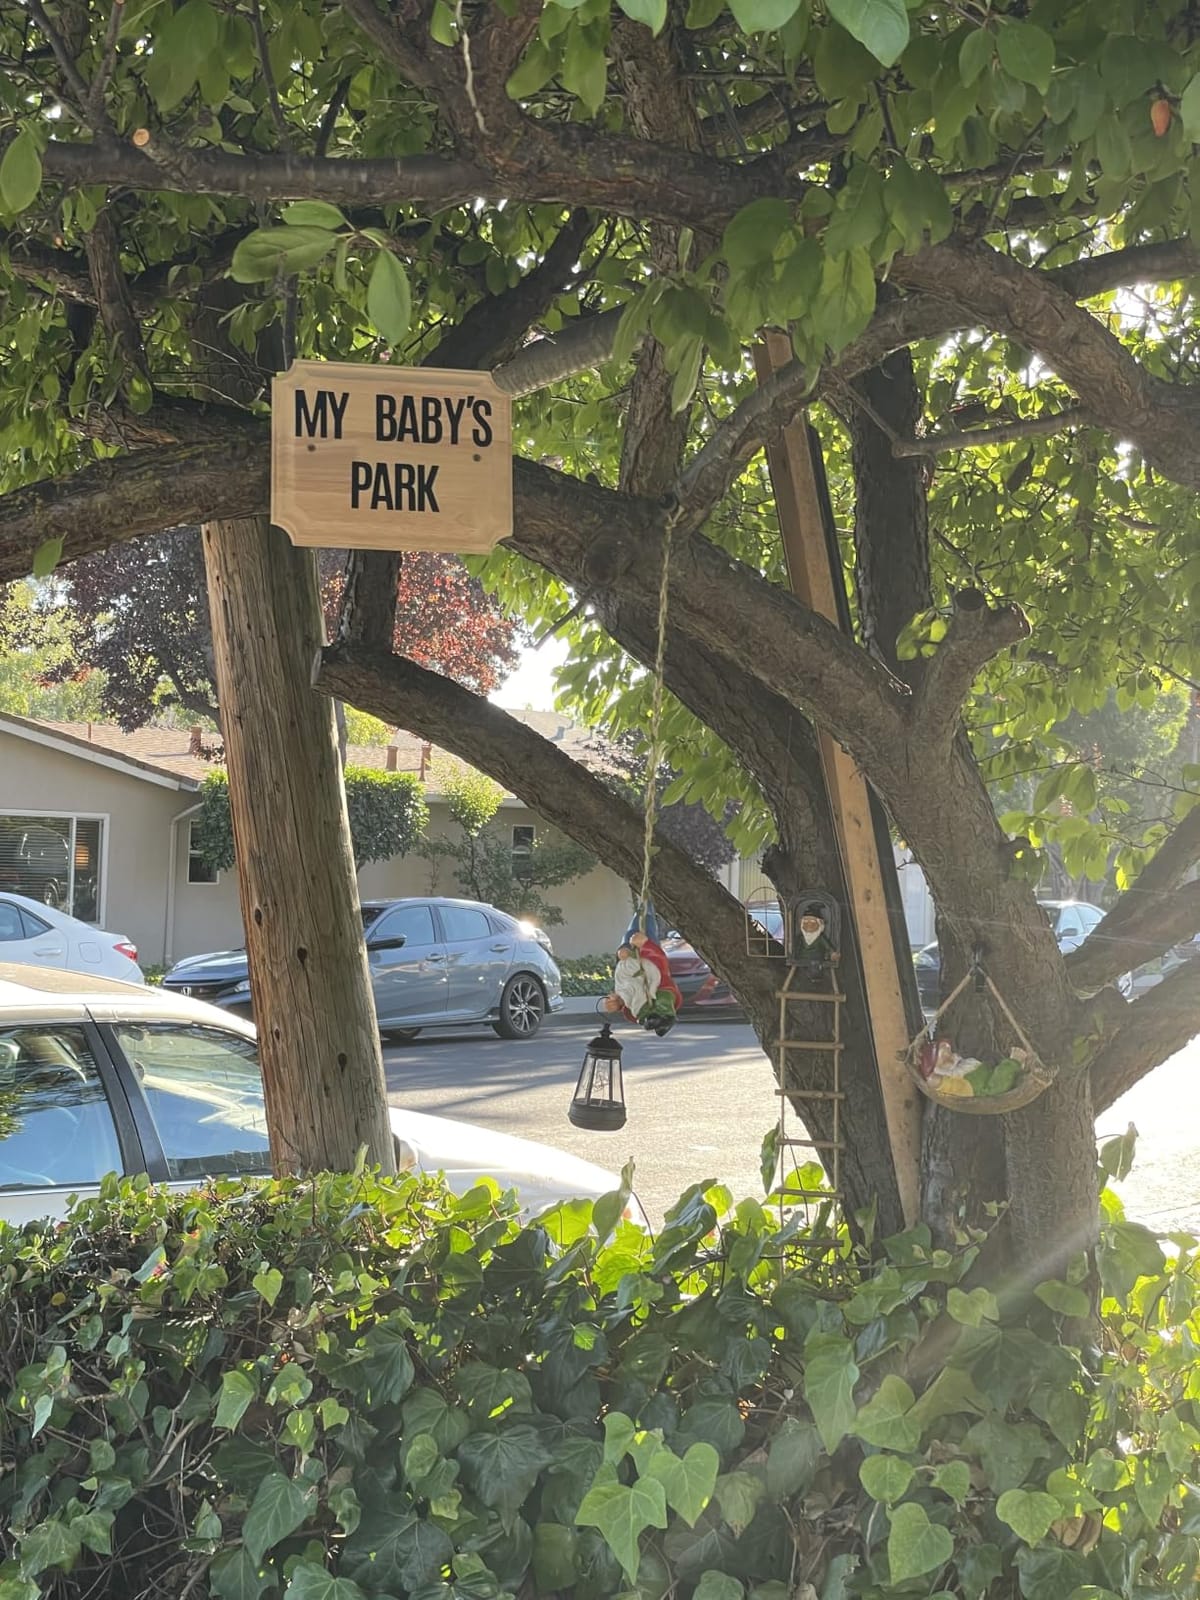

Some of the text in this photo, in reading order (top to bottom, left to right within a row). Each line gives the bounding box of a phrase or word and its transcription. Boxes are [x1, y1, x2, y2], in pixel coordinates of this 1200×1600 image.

[295, 390, 493, 447] MY BABY'S
[352, 462, 440, 513] PARK
